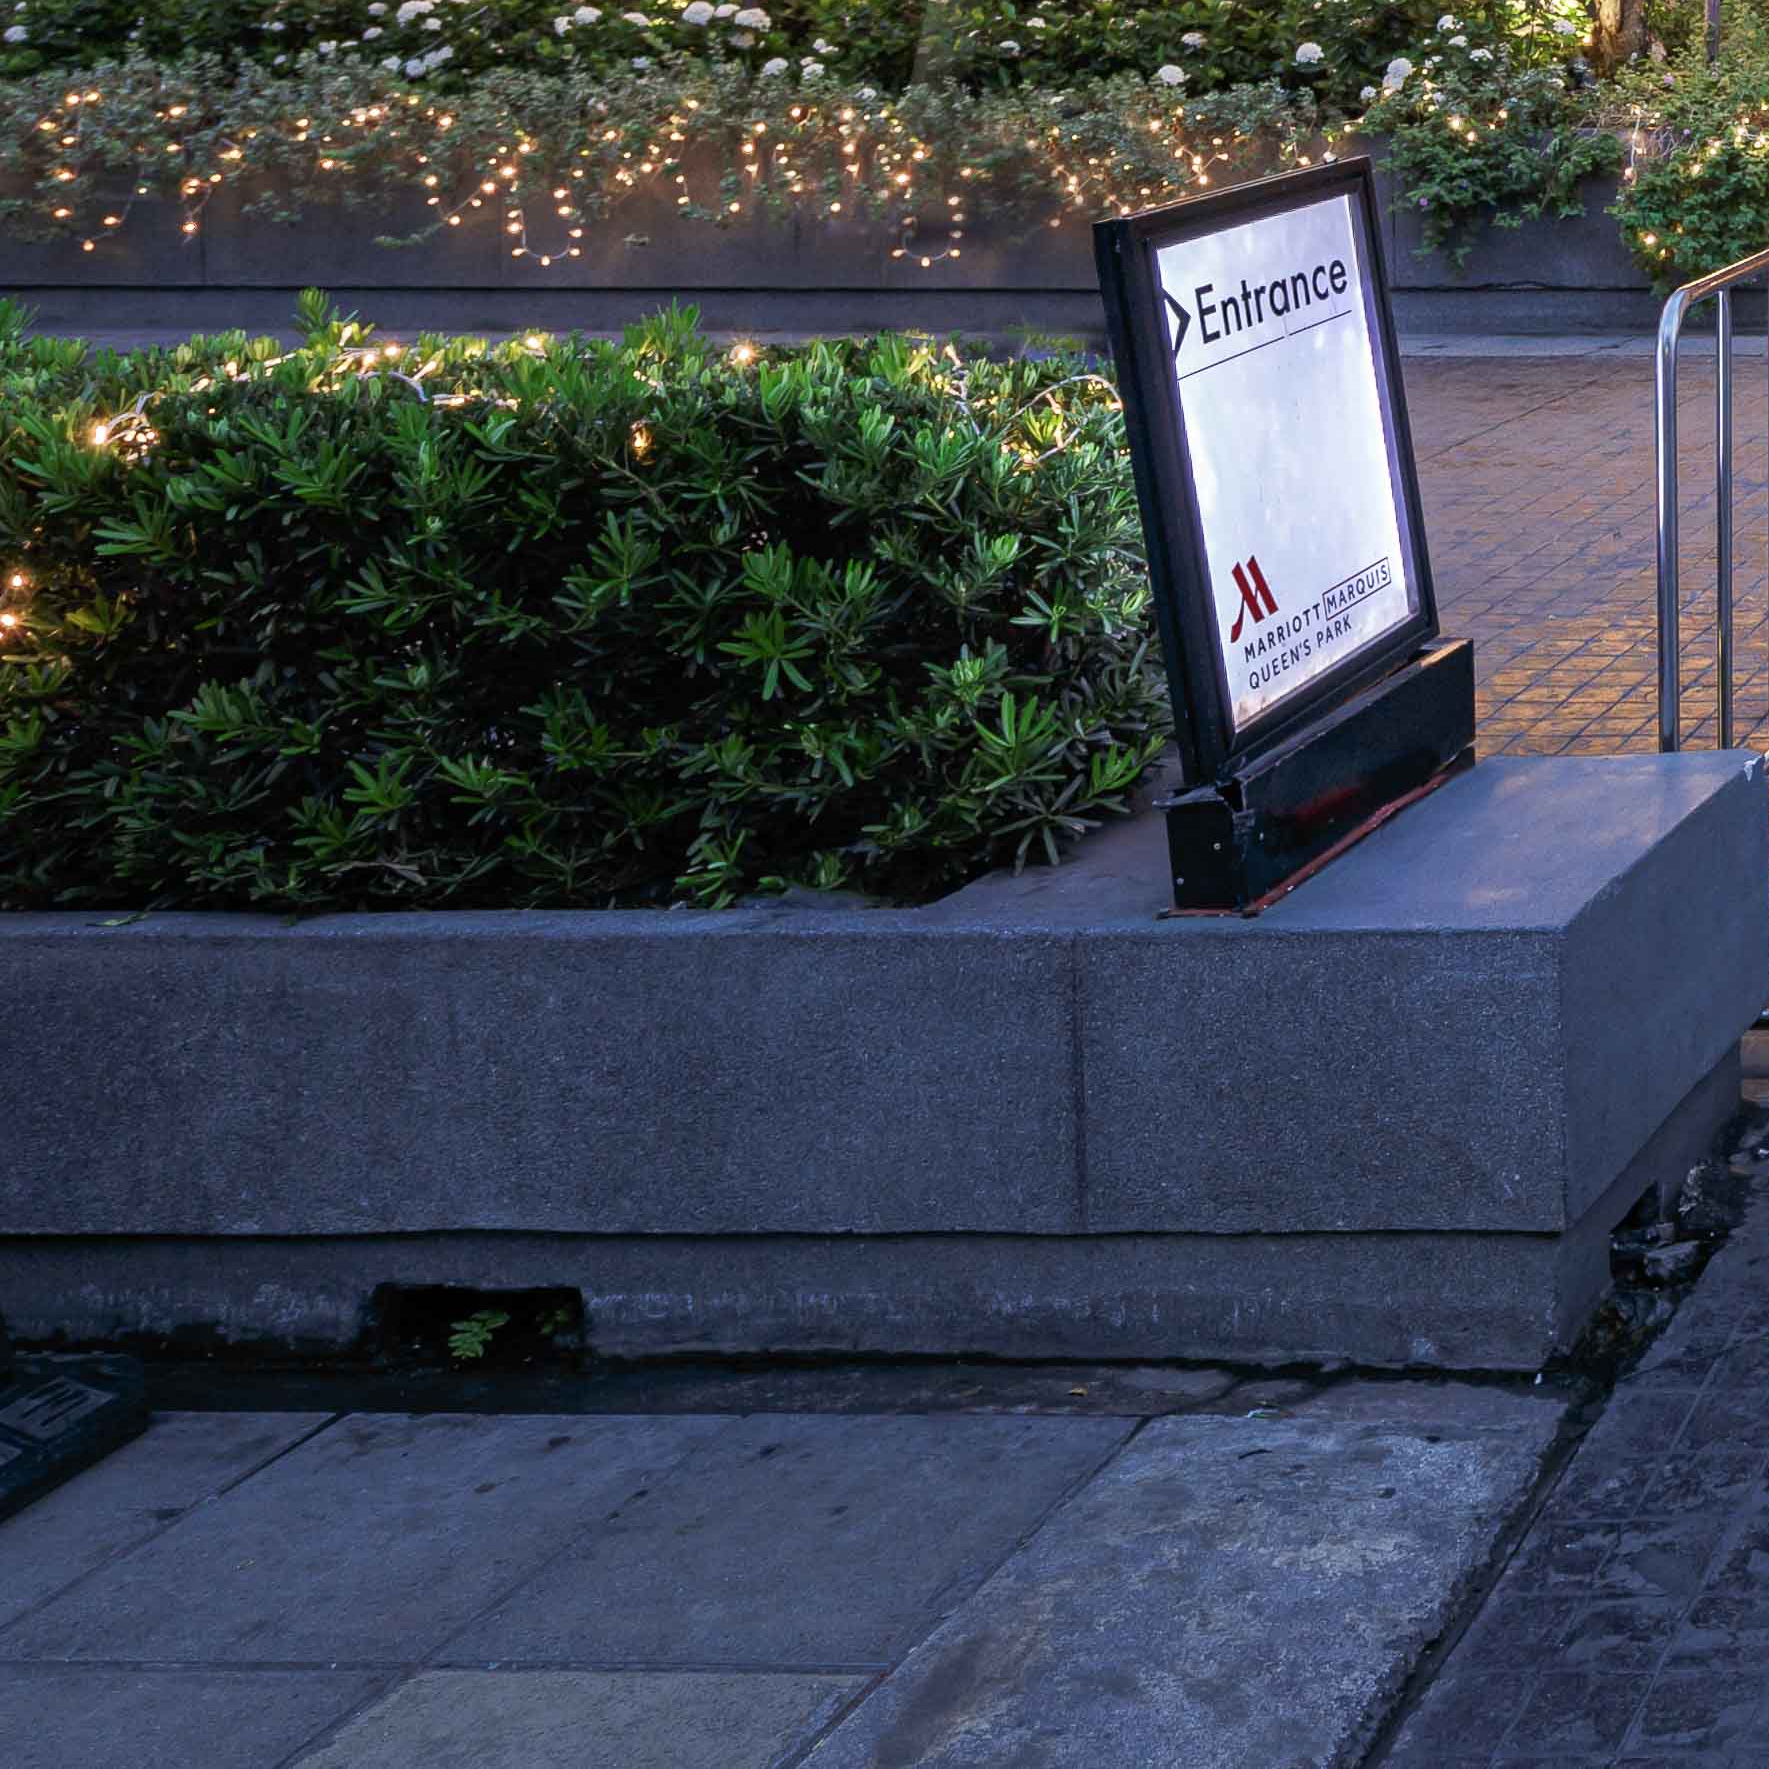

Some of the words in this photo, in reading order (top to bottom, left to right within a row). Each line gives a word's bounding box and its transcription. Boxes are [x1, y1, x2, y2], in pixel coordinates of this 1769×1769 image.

[1195, 259, 1348, 344] Entrance
[1244, 603, 1321, 663] MARRIOTT
[1326, 564, 1389, 614] MARQUIS
[1249, 638, 1312, 690] QUEEN'S
[1316, 613, 1353, 648] PARK
